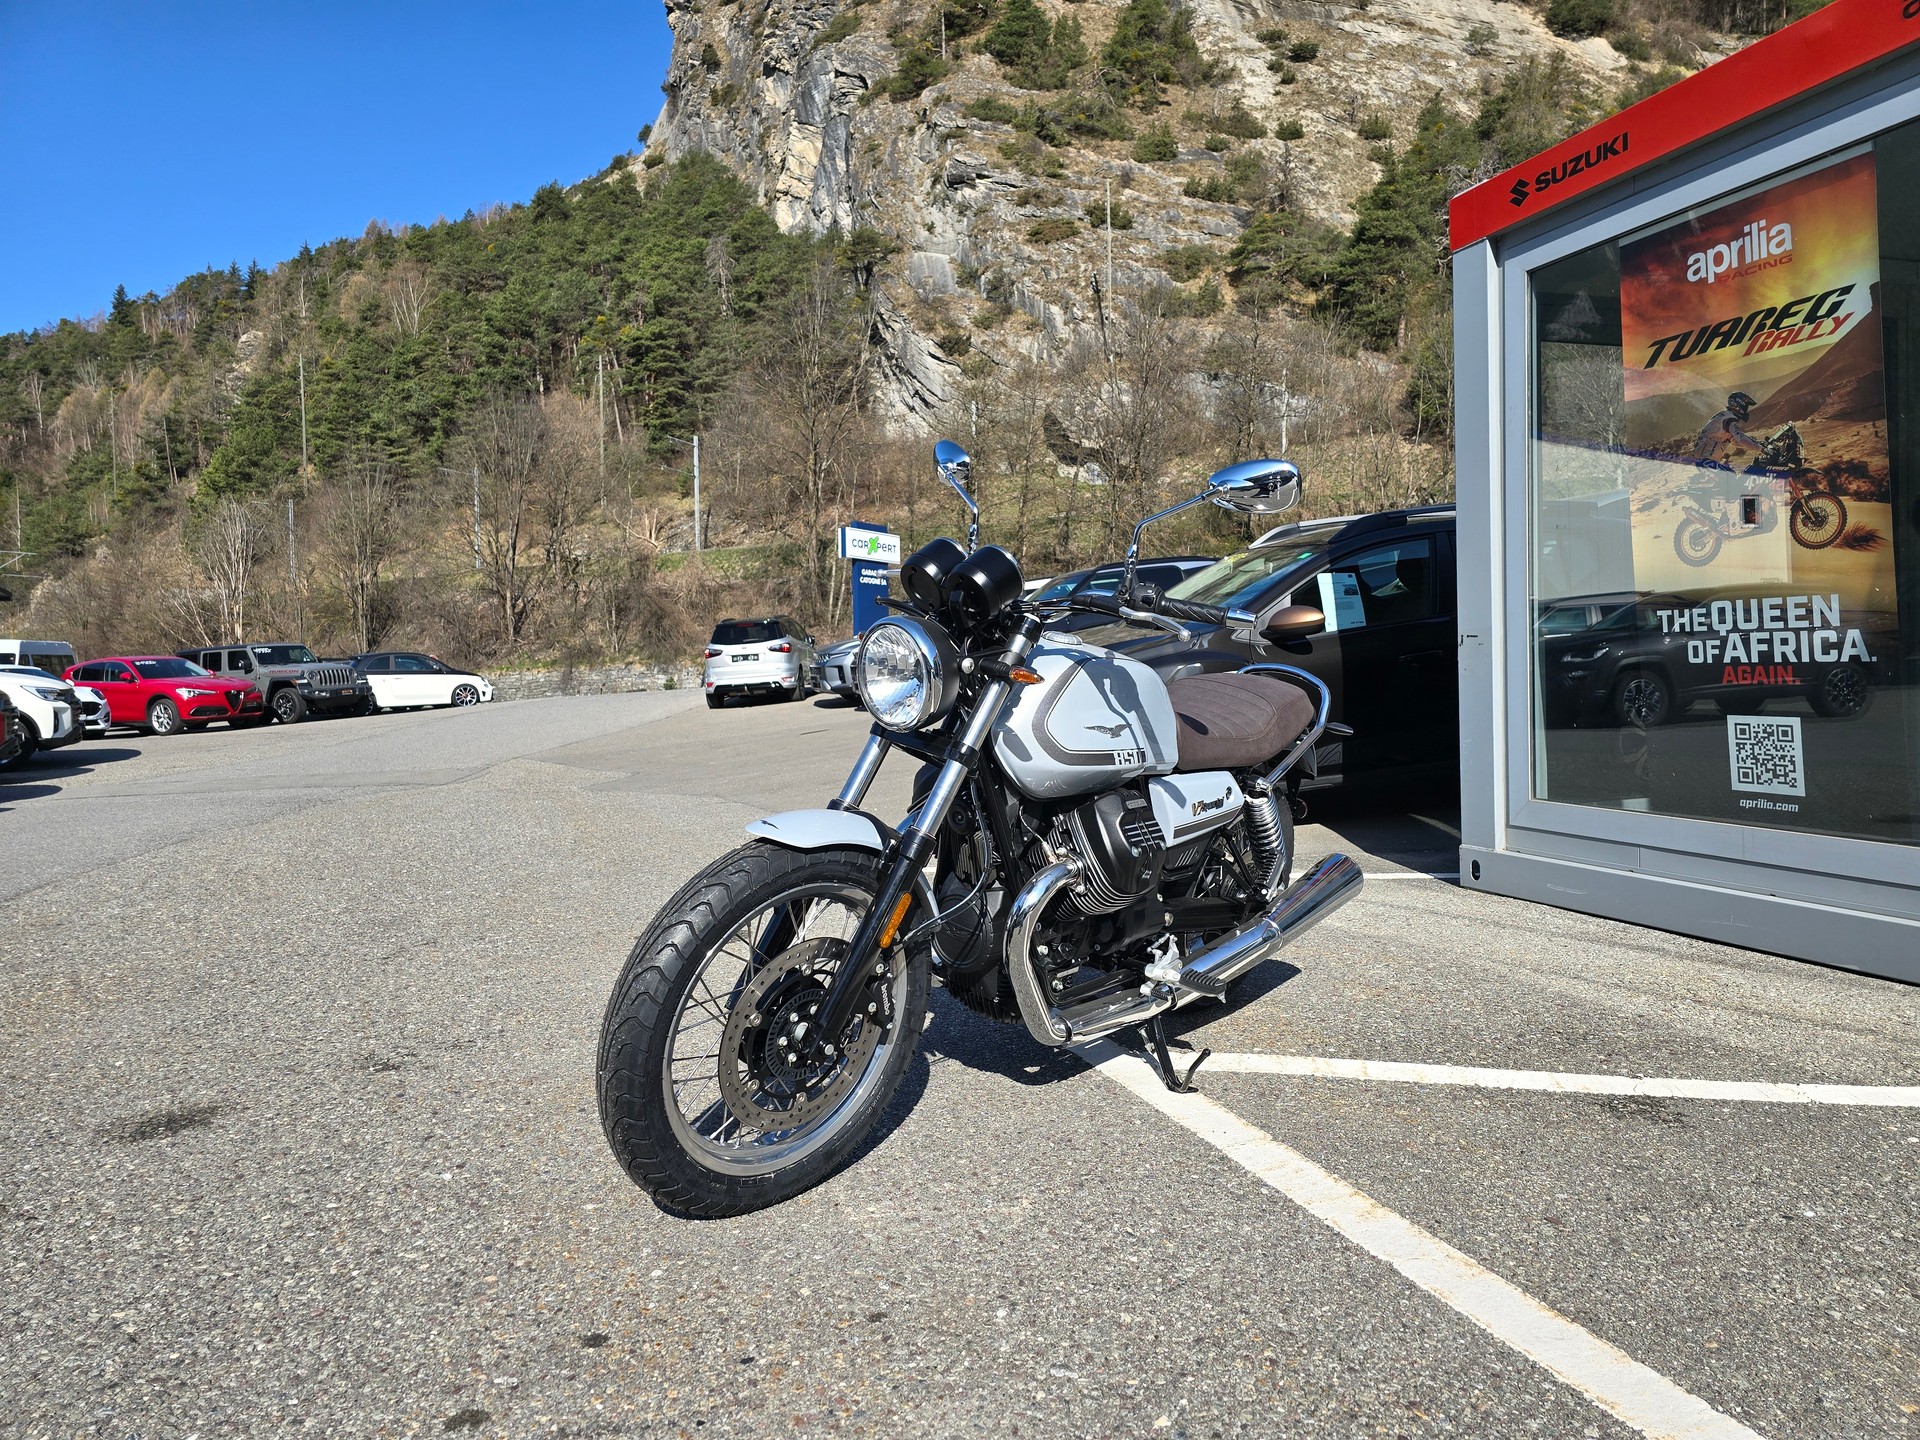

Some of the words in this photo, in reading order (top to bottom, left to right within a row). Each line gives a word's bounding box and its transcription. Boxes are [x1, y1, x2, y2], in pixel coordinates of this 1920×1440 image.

[1534, 131, 1629, 193] SUZUKI
[1686, 218, 1793, 284] aprilia
[1718, 253, 1793, 284] RACING
[1643, 283, 1857, 370] TUAREG
[1743, 311, 1855, 357] RALLY
[1657, 608, 1708, 633] THE
[1710, 593, 1841, 636] QUEEN
[1687, 640, 1721, 664] OF
[1723, 628, 1878, 664] AFRICA.
[1722, 665, 1801, 685] AGAIN.
[1739, 797, 1799, 813] aprilia.com
[881, 983, 890, 1015] brembo
